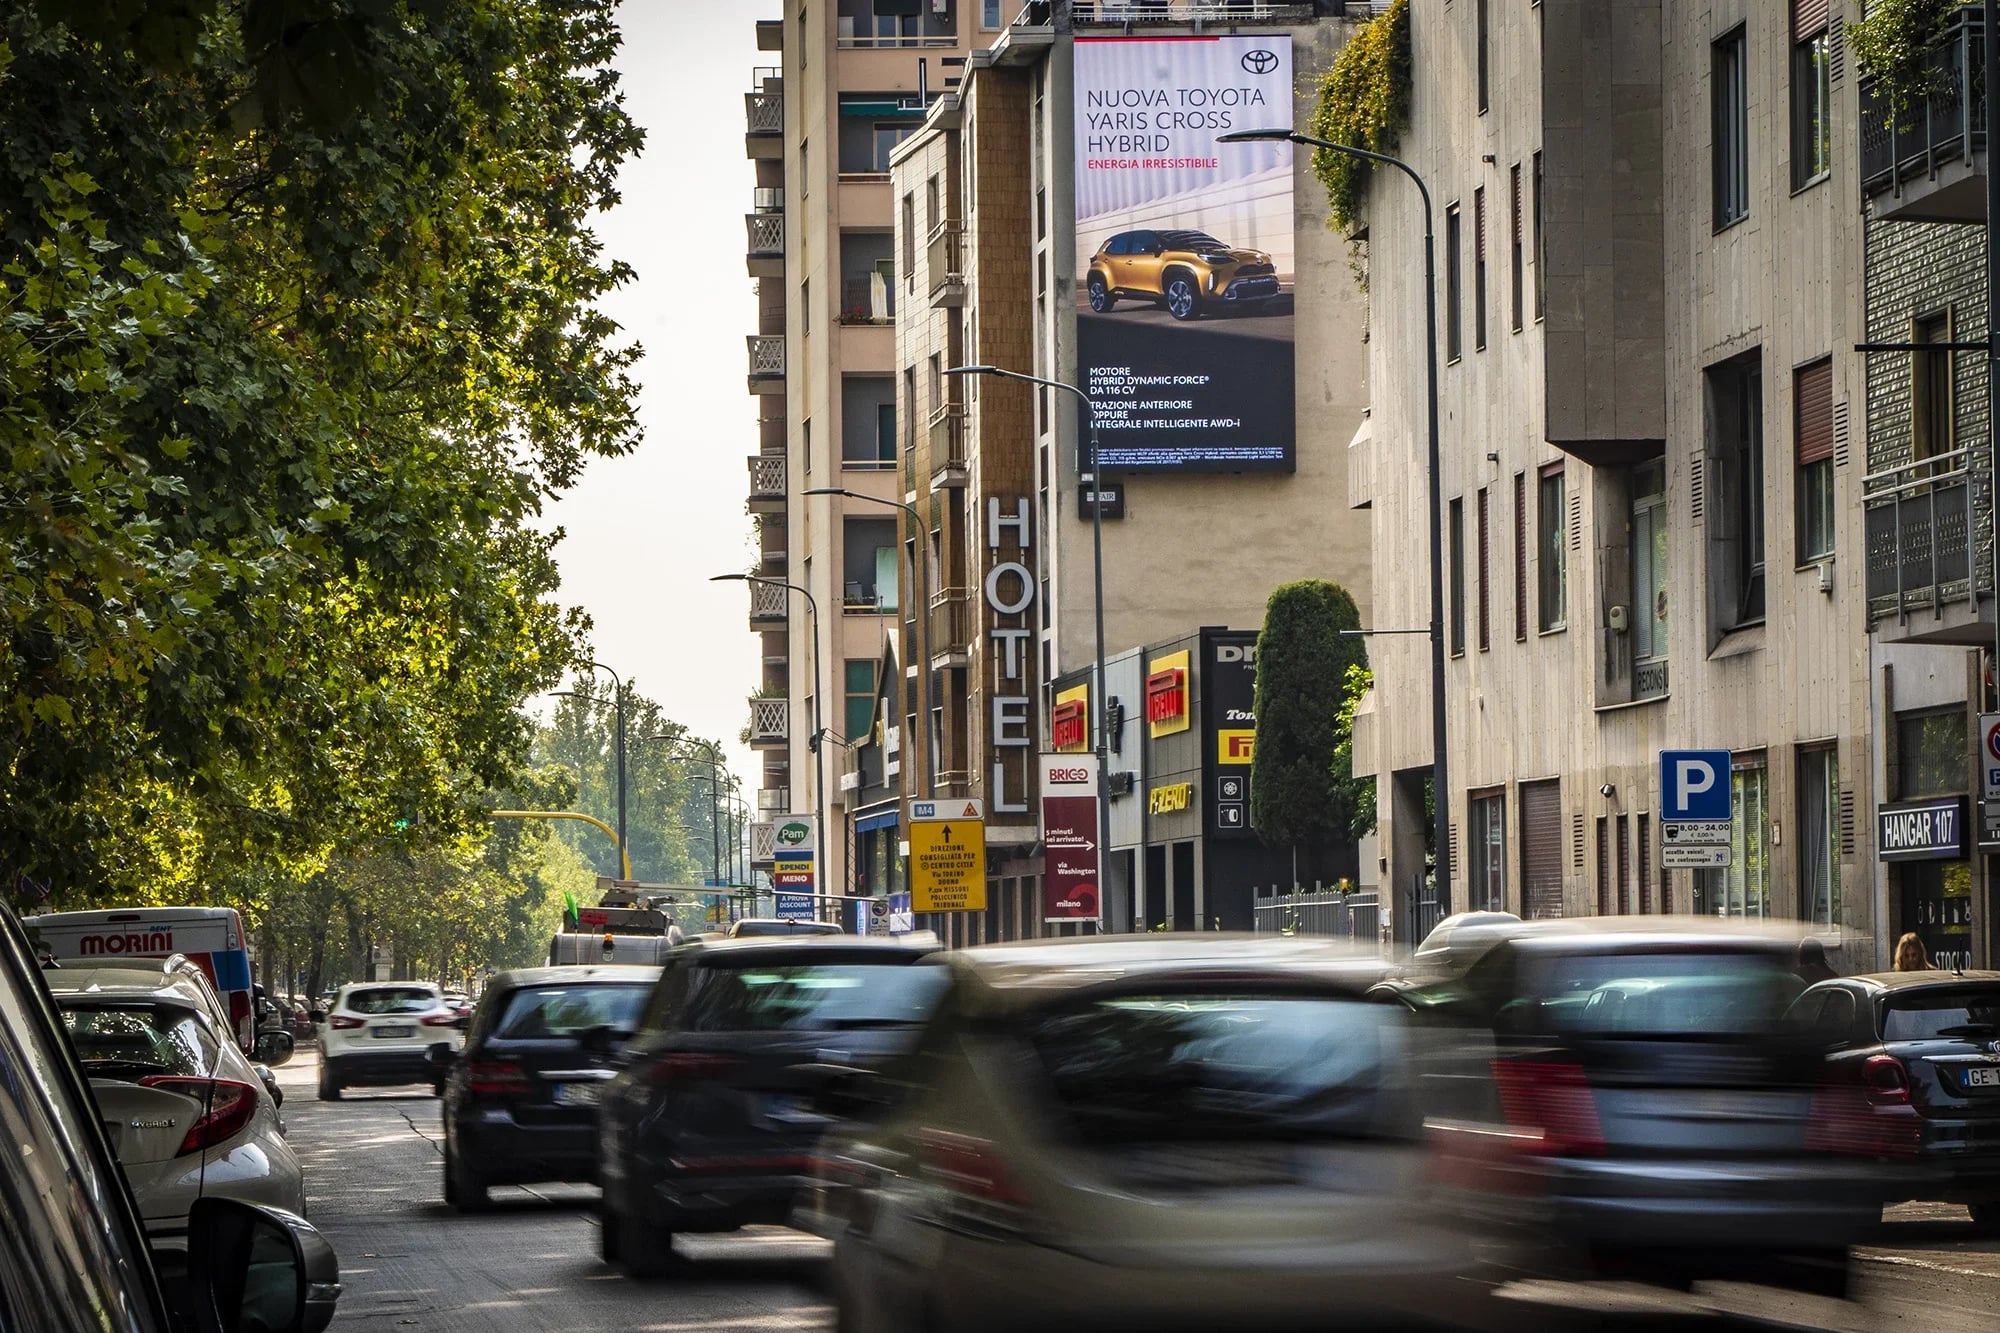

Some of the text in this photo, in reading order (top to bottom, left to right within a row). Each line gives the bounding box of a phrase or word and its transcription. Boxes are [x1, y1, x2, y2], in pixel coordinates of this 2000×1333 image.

[1087, 88, 1266, 107] NUOVA TOYOTA
[1087, 111, 1232, 130] YARIS CROSS
[1088, 135, 1170, 152] HYBRID
[1088, 158, 1218, 169] ENERGIA IRRESISTIBILE
[1090, 367, 1131, 376] MOTORE
[1090, 377, 1125, 385] HYBRID
[1127, 376, 1172, 385] DYNAMIC
[1090, 386, 1136, 395] DA 116 CV
[1090, 400, 1193, 410] TRAZIONE ANTERIORE
[1143, 419, 1208, 428] INTELLIGENTE
[1210, 418, 1241, 428] AWD-i
[985, 496, 1034, 813] HOTEL
[782, 829, 804, 839] Pam
[1885, 811, 1953, 848] HANGAR 107
[930, 844, 965, 852] DIREZIONE
[1057, 861, 1068, 869] via
[1057, 868, 1096, 876] Washington
[782, 875, 808, 883] MENO
[1056, 900, 1081, 908] milano
